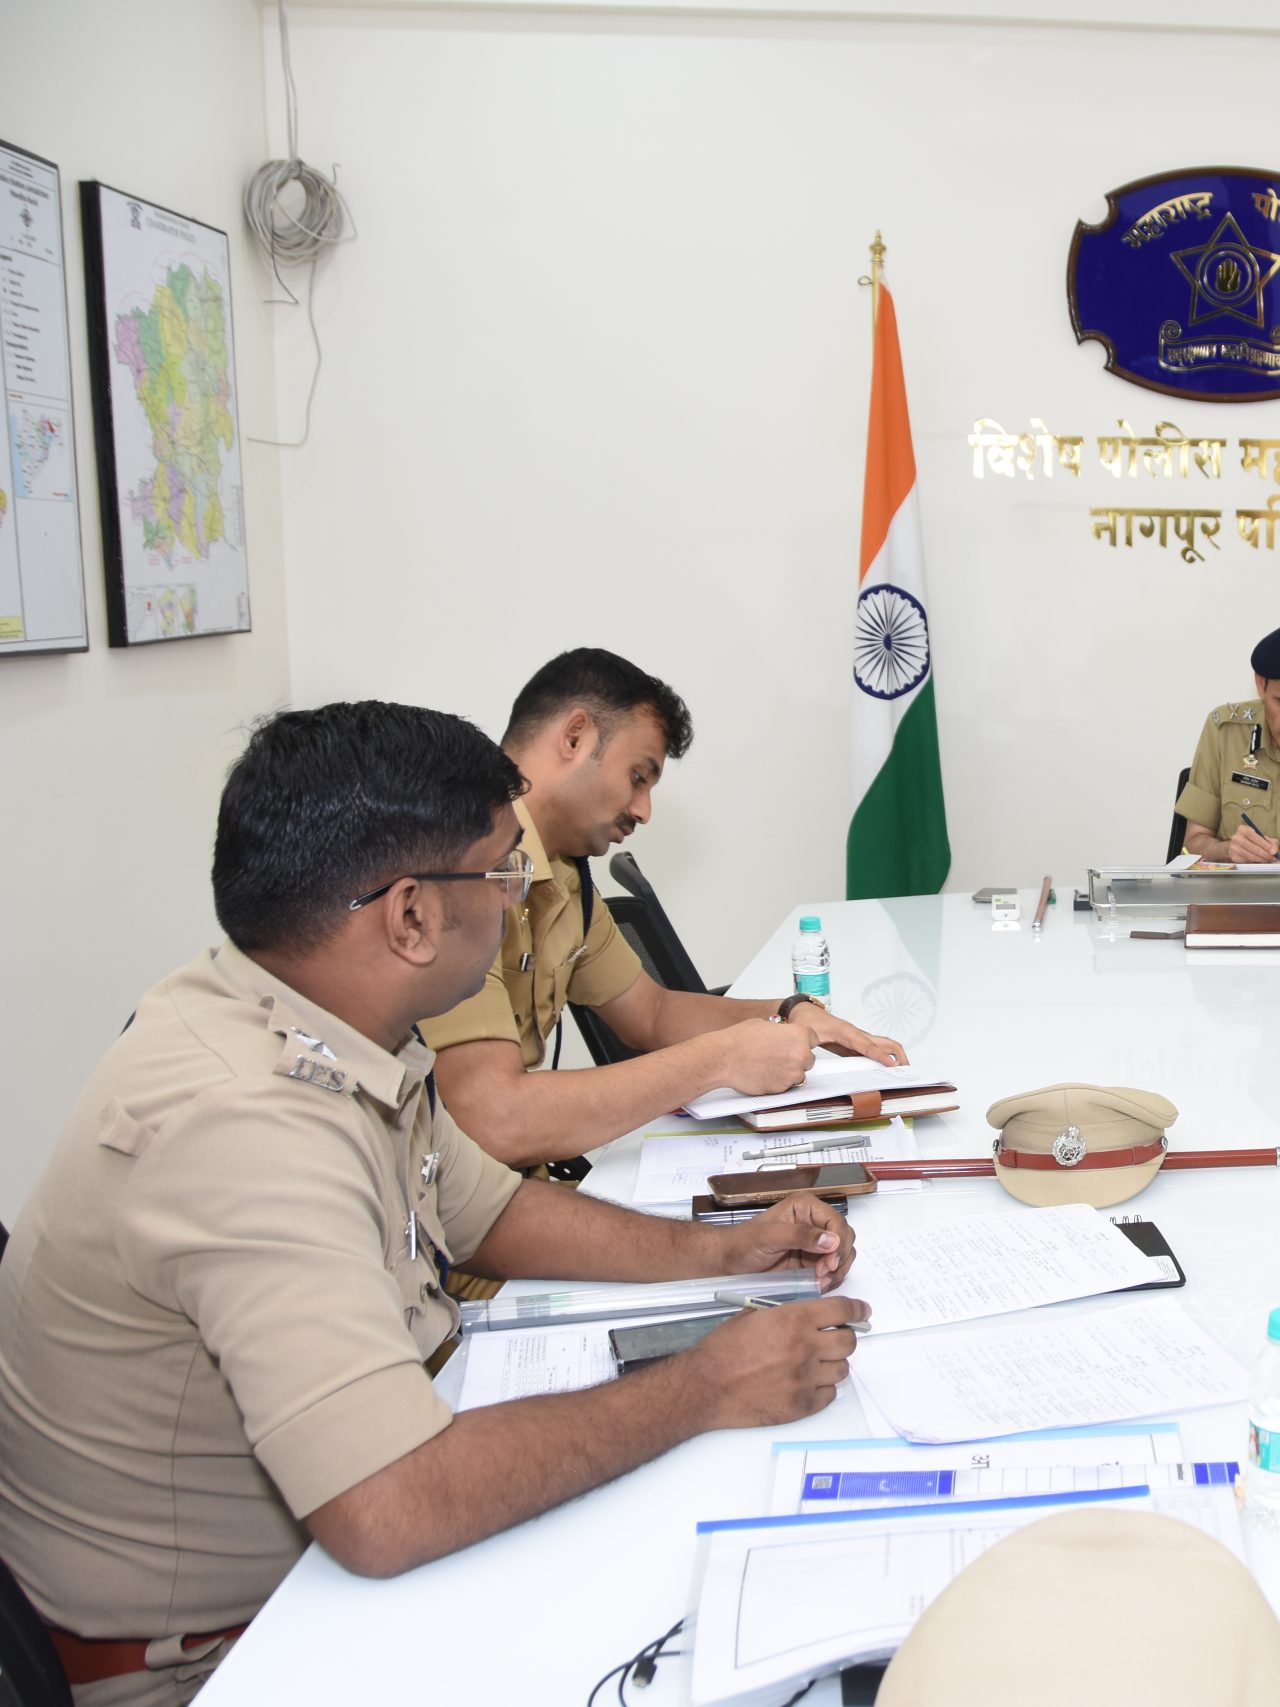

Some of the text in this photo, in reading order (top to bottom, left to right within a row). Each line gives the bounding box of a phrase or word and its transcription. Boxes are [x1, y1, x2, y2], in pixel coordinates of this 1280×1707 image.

[1121, 192, 1213, 246] महाराष्ट्र
[968, 418, 1084, 480] विशेष
[1097, 418, 1227, 479] पोलीस
[1089, 507, 1222, 563] नागपूर
